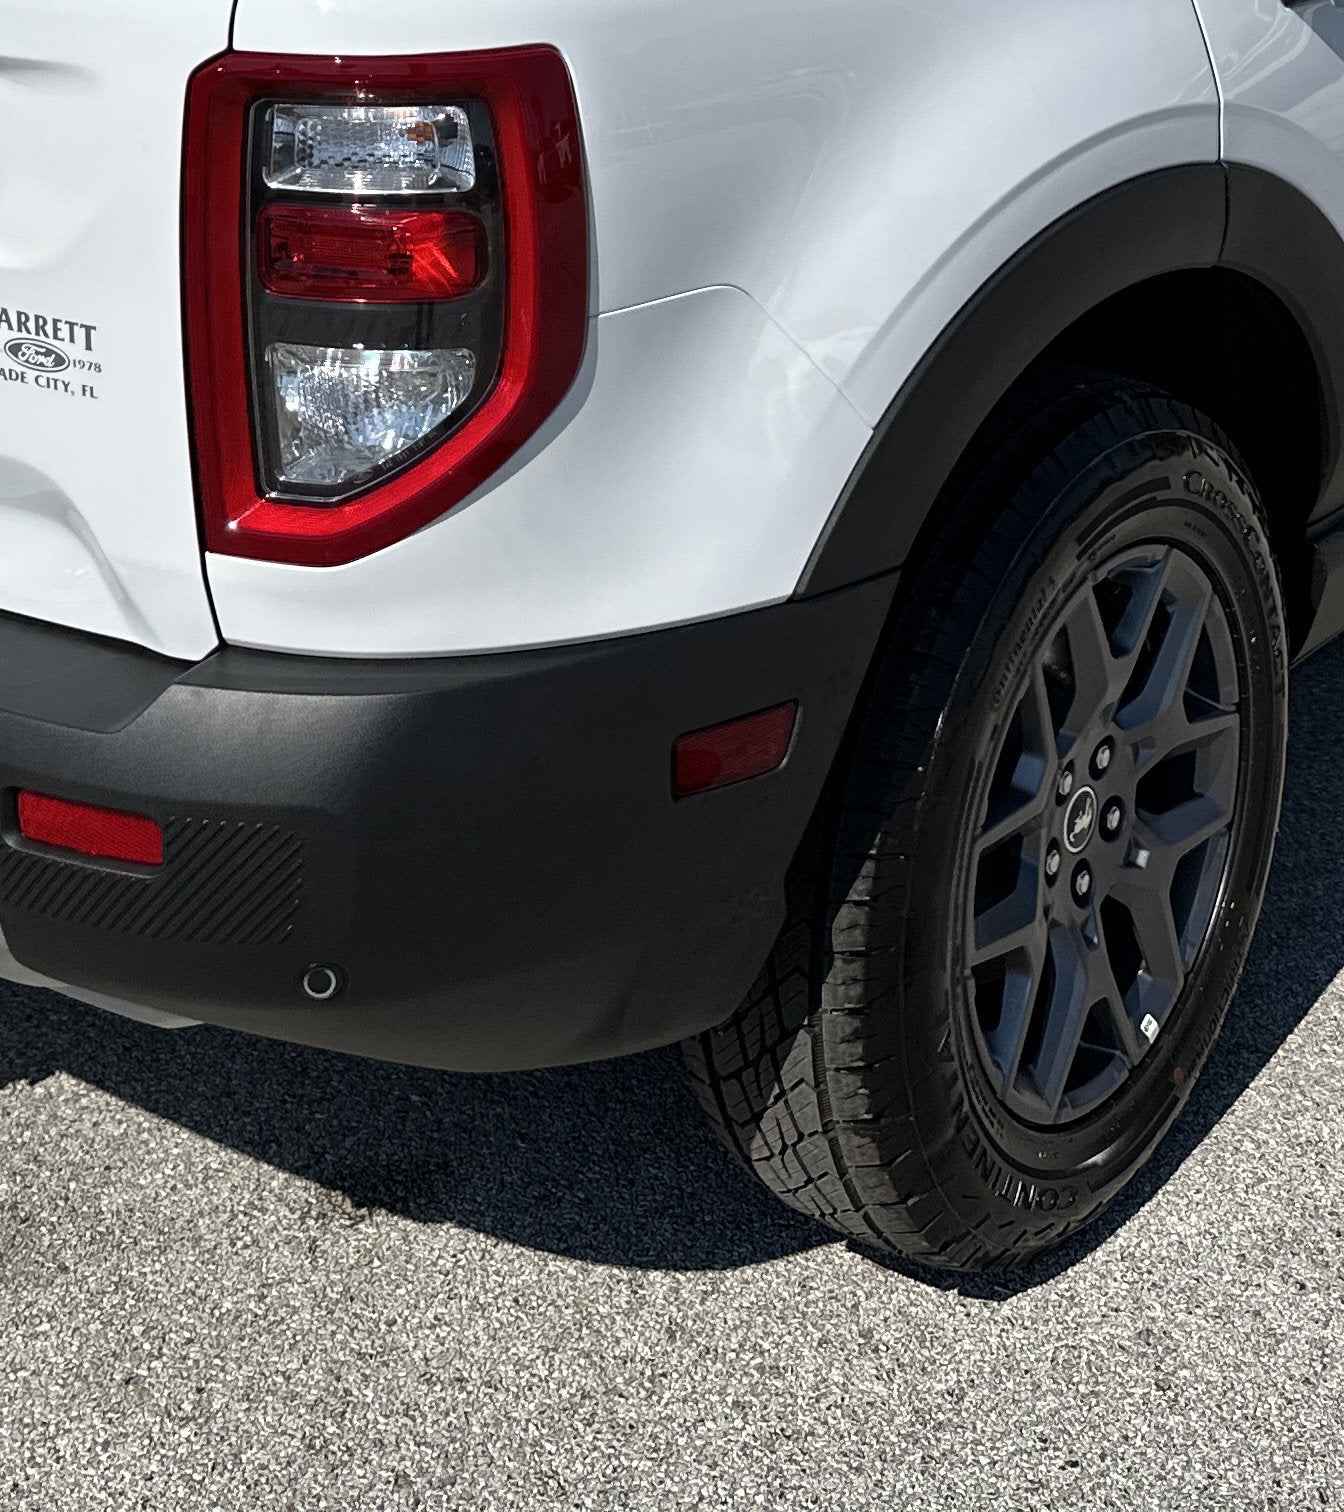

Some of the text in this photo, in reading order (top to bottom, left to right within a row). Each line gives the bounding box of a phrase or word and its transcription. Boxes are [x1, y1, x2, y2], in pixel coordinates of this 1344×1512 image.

[17, 343, 56, 368] Ford
[72, 359, 102, 373] 1978
[34, 374, 76, 396] CITY,
[81, 384, 99, 399] FL
